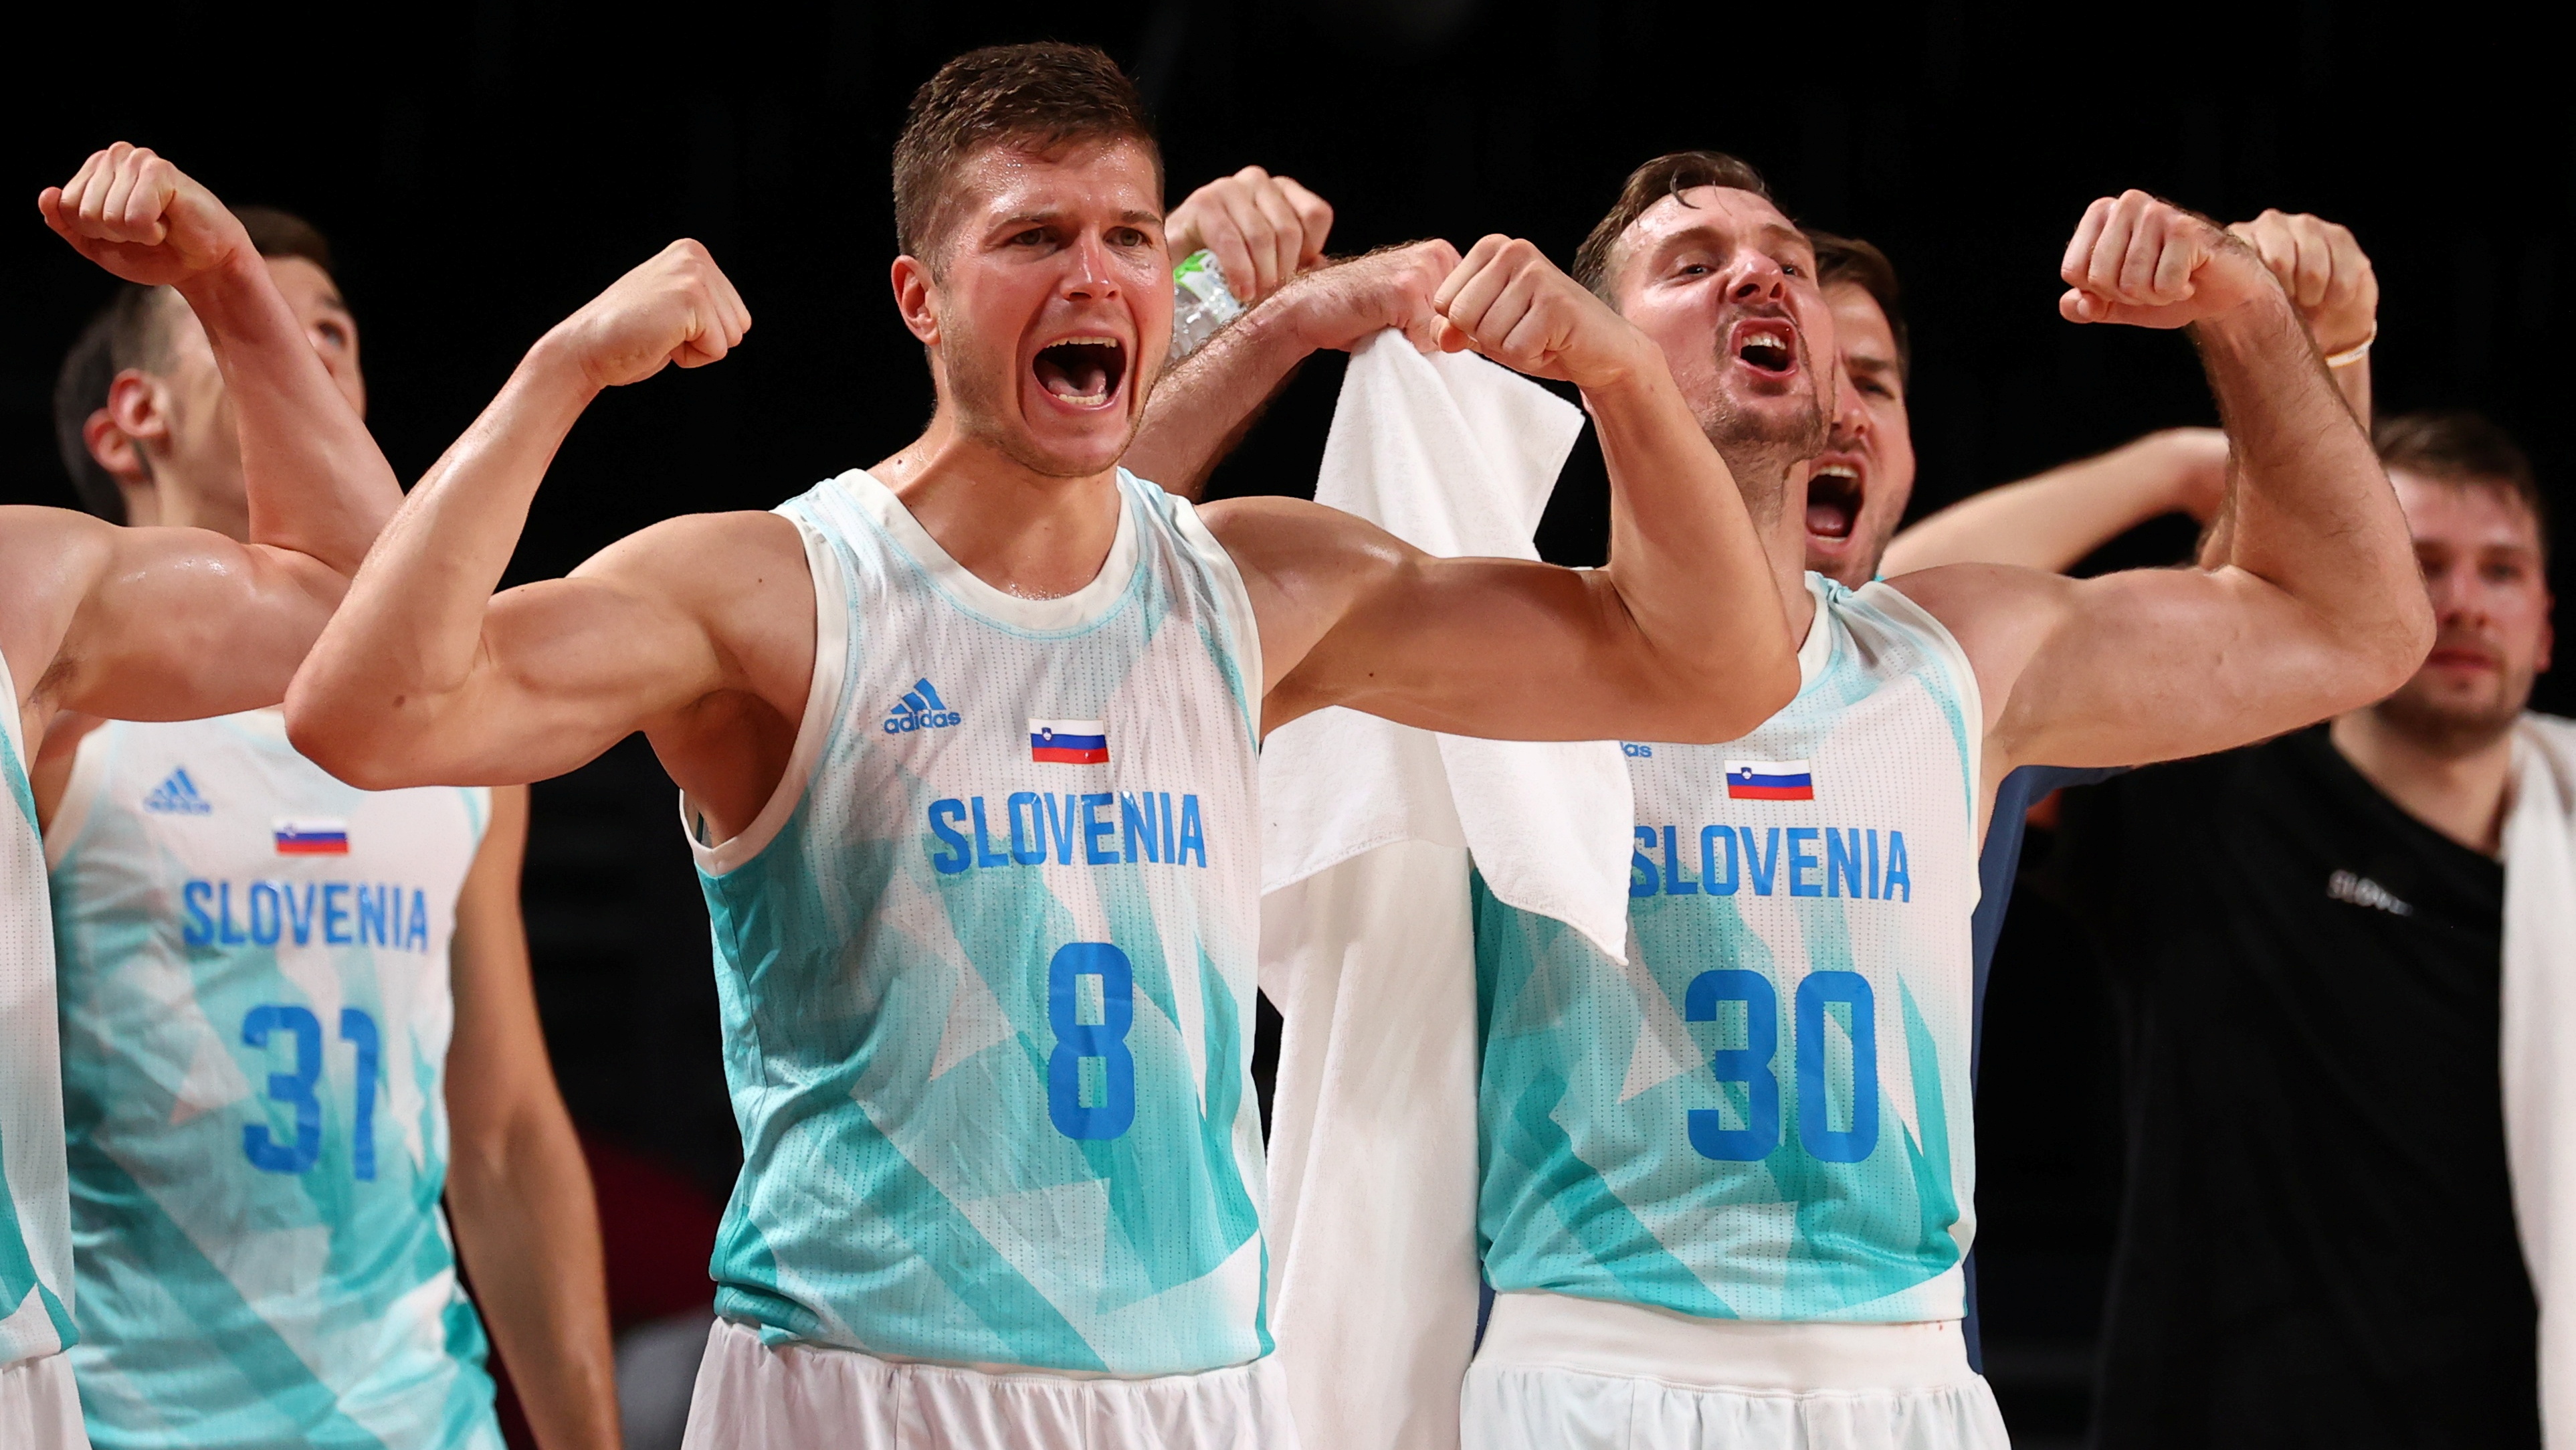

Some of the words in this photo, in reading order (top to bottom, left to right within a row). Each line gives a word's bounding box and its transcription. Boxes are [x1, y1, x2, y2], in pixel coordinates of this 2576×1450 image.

[884, 708, 961, 734] adidas
[928, 791, 1207, 875] SLOVENIA
[1628, 824, 1910, 903] SLOVENIA
[183, 879, 429, 952] SLOVENIA
[1048, 942, 1136, 1140] 8
[1685, 969, 1879, 1163] 30
[241, 1005, 379, 1182] 31
